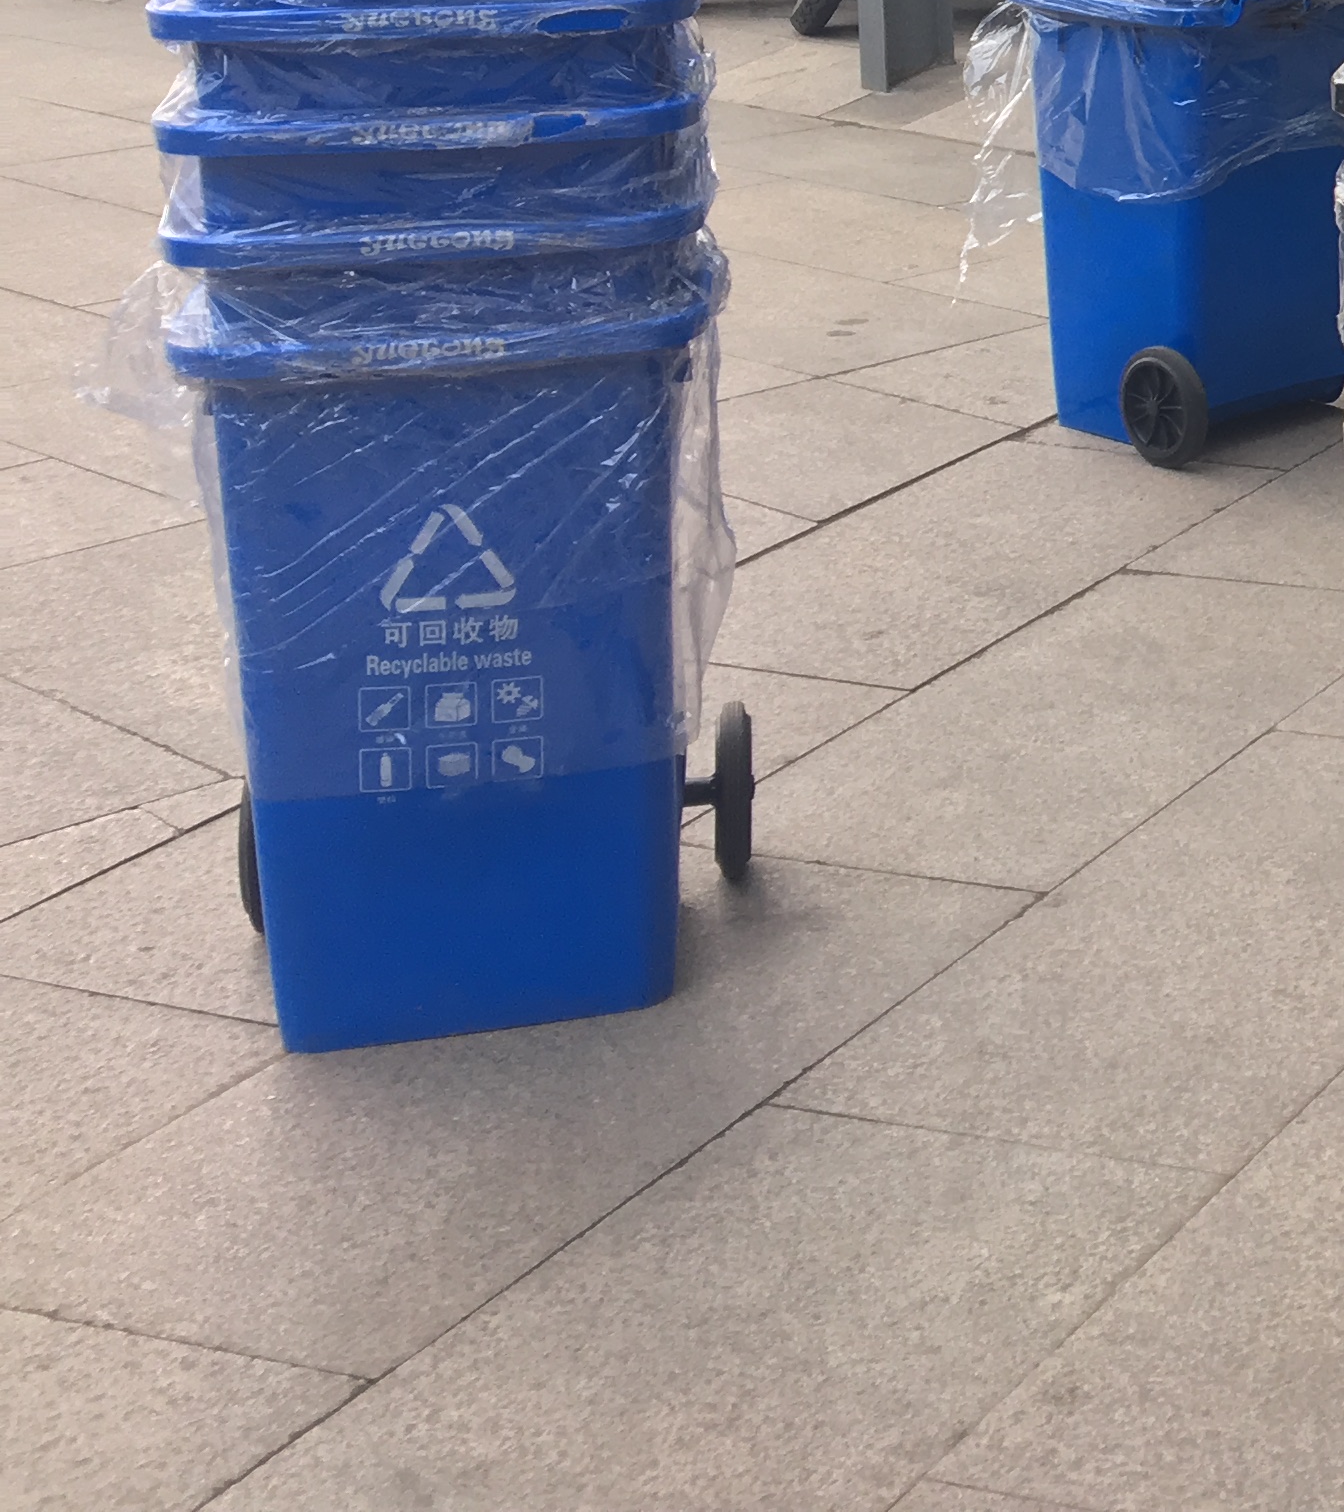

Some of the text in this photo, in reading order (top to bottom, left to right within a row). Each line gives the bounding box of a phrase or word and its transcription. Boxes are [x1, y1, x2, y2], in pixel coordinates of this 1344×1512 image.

[384, 615, 519, 648] 可回收物
[366, 648, 533, 678] Recyclable waste
